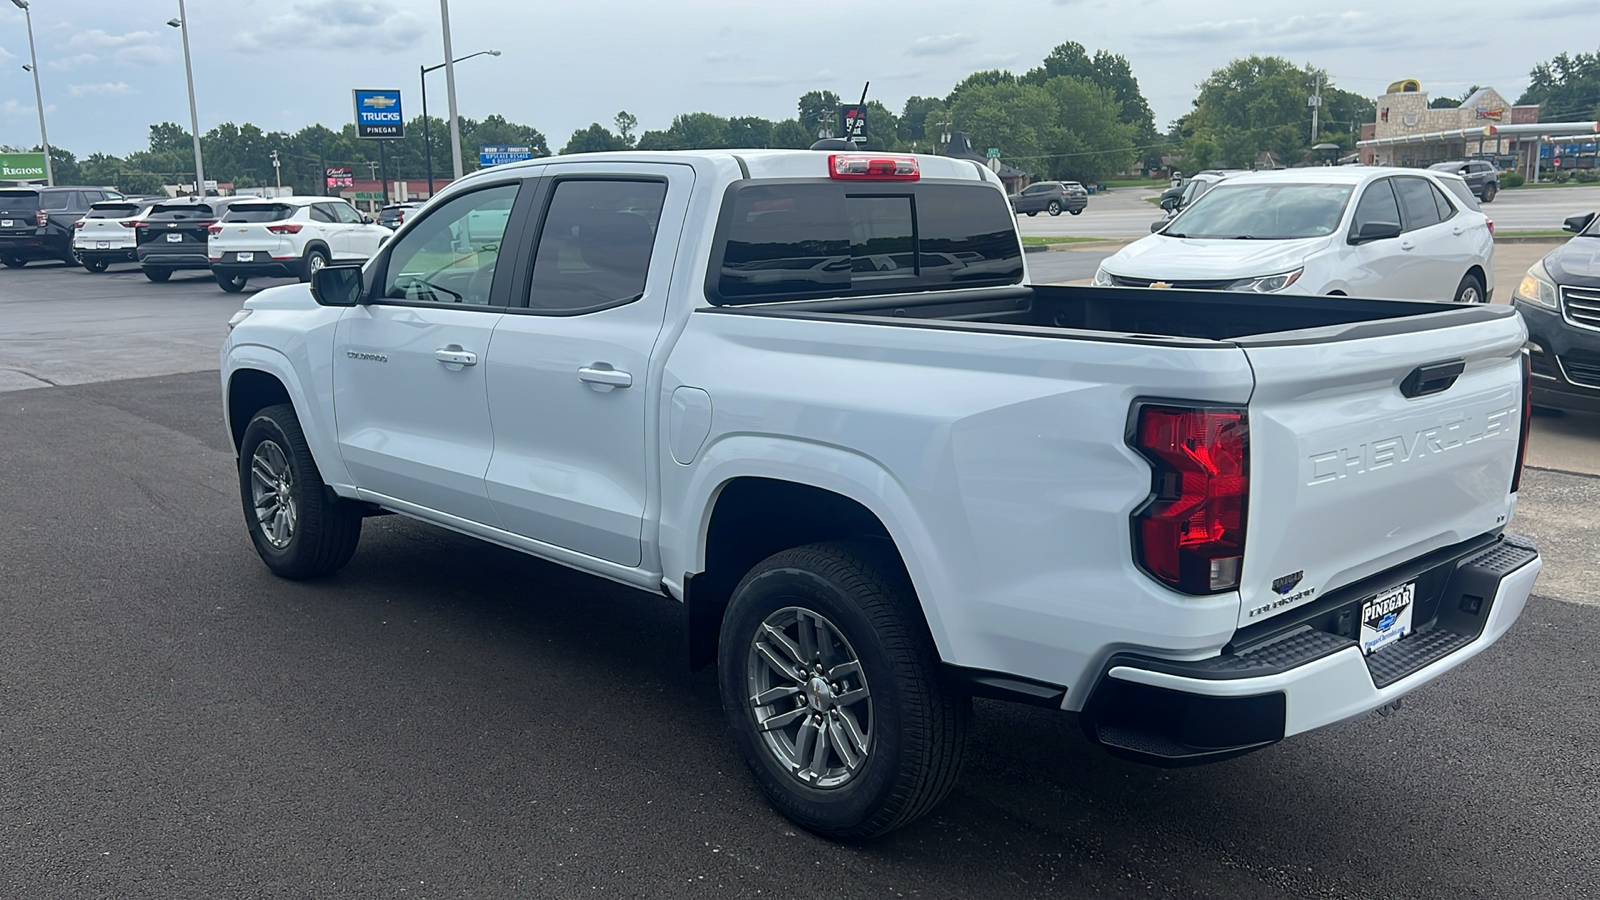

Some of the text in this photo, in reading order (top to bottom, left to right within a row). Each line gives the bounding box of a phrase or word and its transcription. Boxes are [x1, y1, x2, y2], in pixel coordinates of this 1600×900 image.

[361, 112, 400, 121] TRUCKS
[846, 117, 864, 127] Piza
[347, 351, 387, 362] COLORADO
[1307, 405, 1517, 486] CHEVROLET
[1272, 571, 1304, 588] PINEGAR
[1364, 591, 1410, 622] PINEGAR
